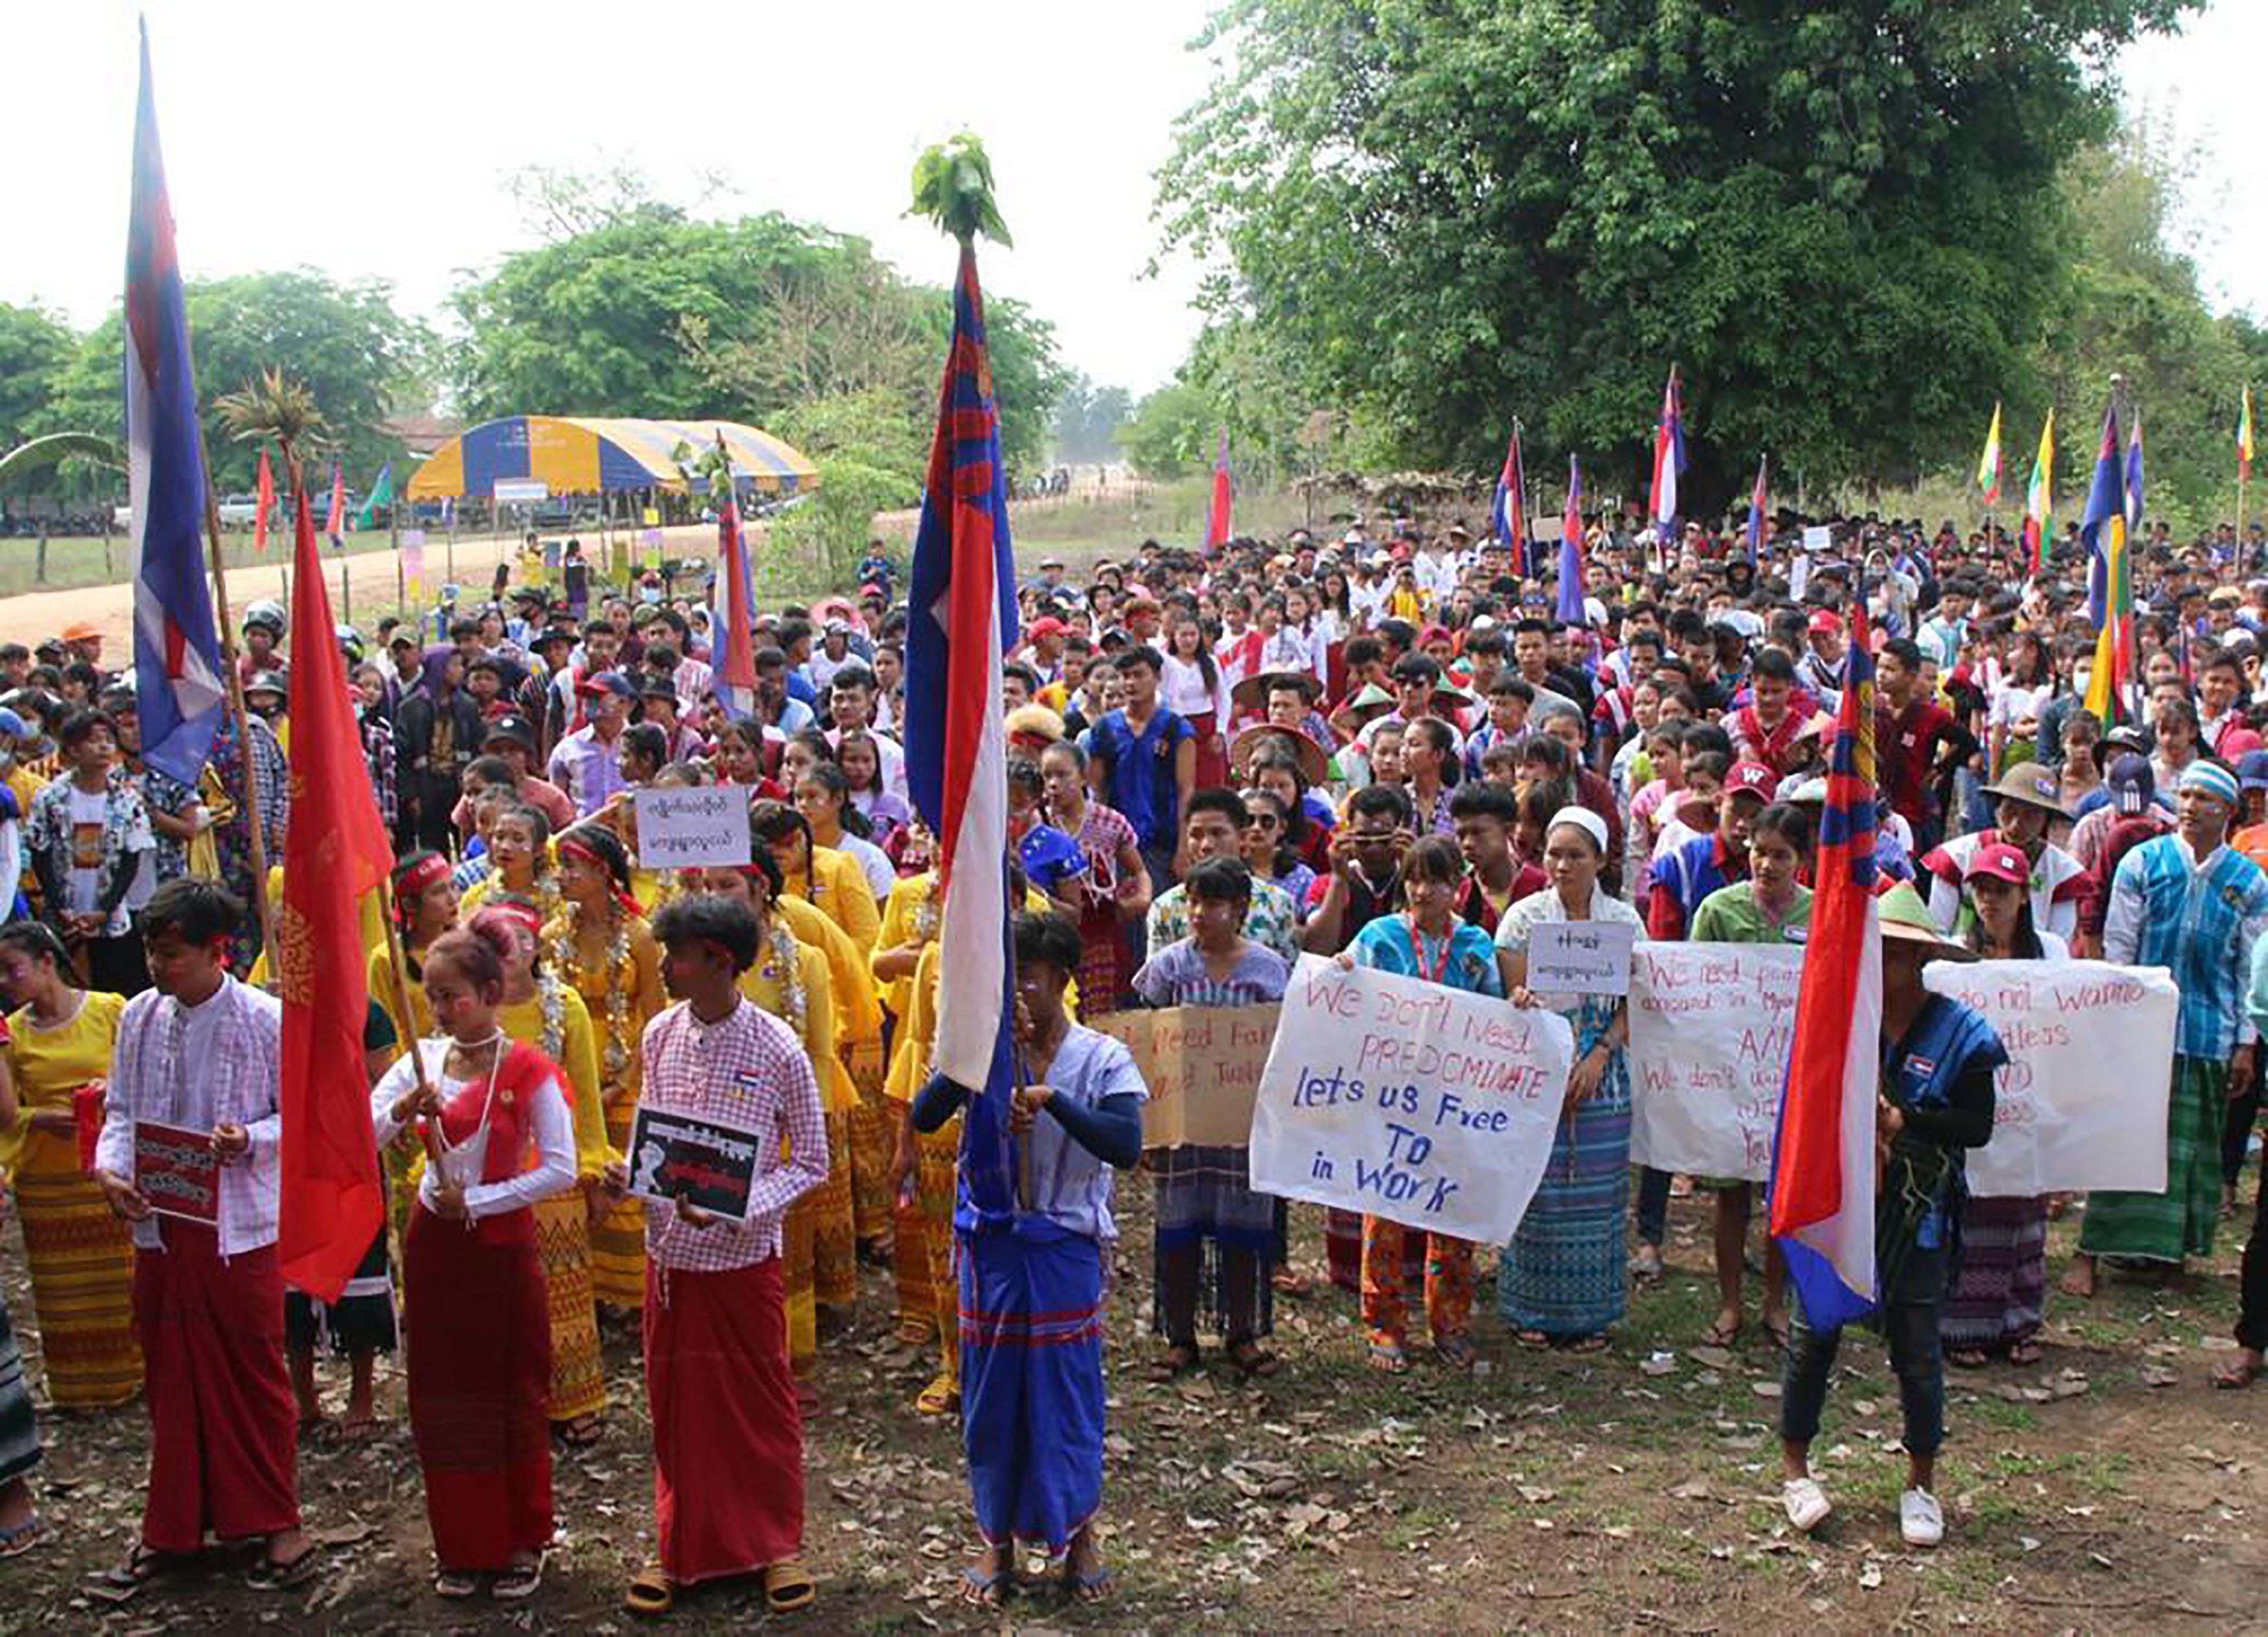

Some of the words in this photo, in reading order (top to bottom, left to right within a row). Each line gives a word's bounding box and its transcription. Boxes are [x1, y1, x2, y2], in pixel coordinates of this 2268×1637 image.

[1305, 972, 1363, 1017] We
[1379, 1084, 1419, 1115] us
[1312, 1152, 1333, 1180] in
